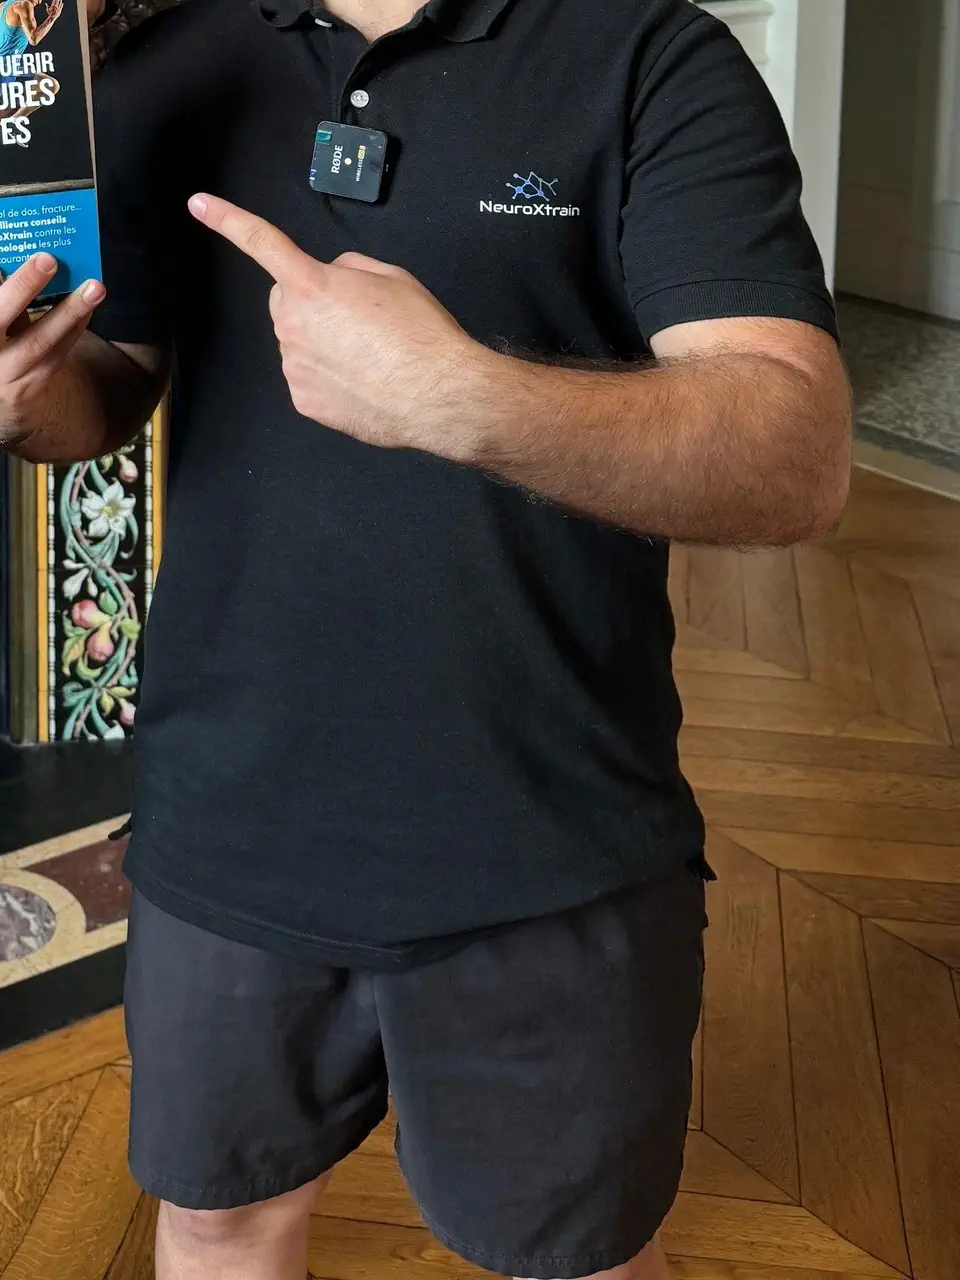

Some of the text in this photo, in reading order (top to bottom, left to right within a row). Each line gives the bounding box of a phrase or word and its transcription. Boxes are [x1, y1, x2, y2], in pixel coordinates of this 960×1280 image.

[8, 208, 19, 218] de
[21, 206, 40, 217] dos,
[479, 200, 581, 217] NeuroXtrain
[30, 215, 67, 226] conseils
[34, 228, 62, 238] contre
[63, 225, 76, 234] les
[38, 239, 52, 248] les
[53, 237, 72, 249] plus
